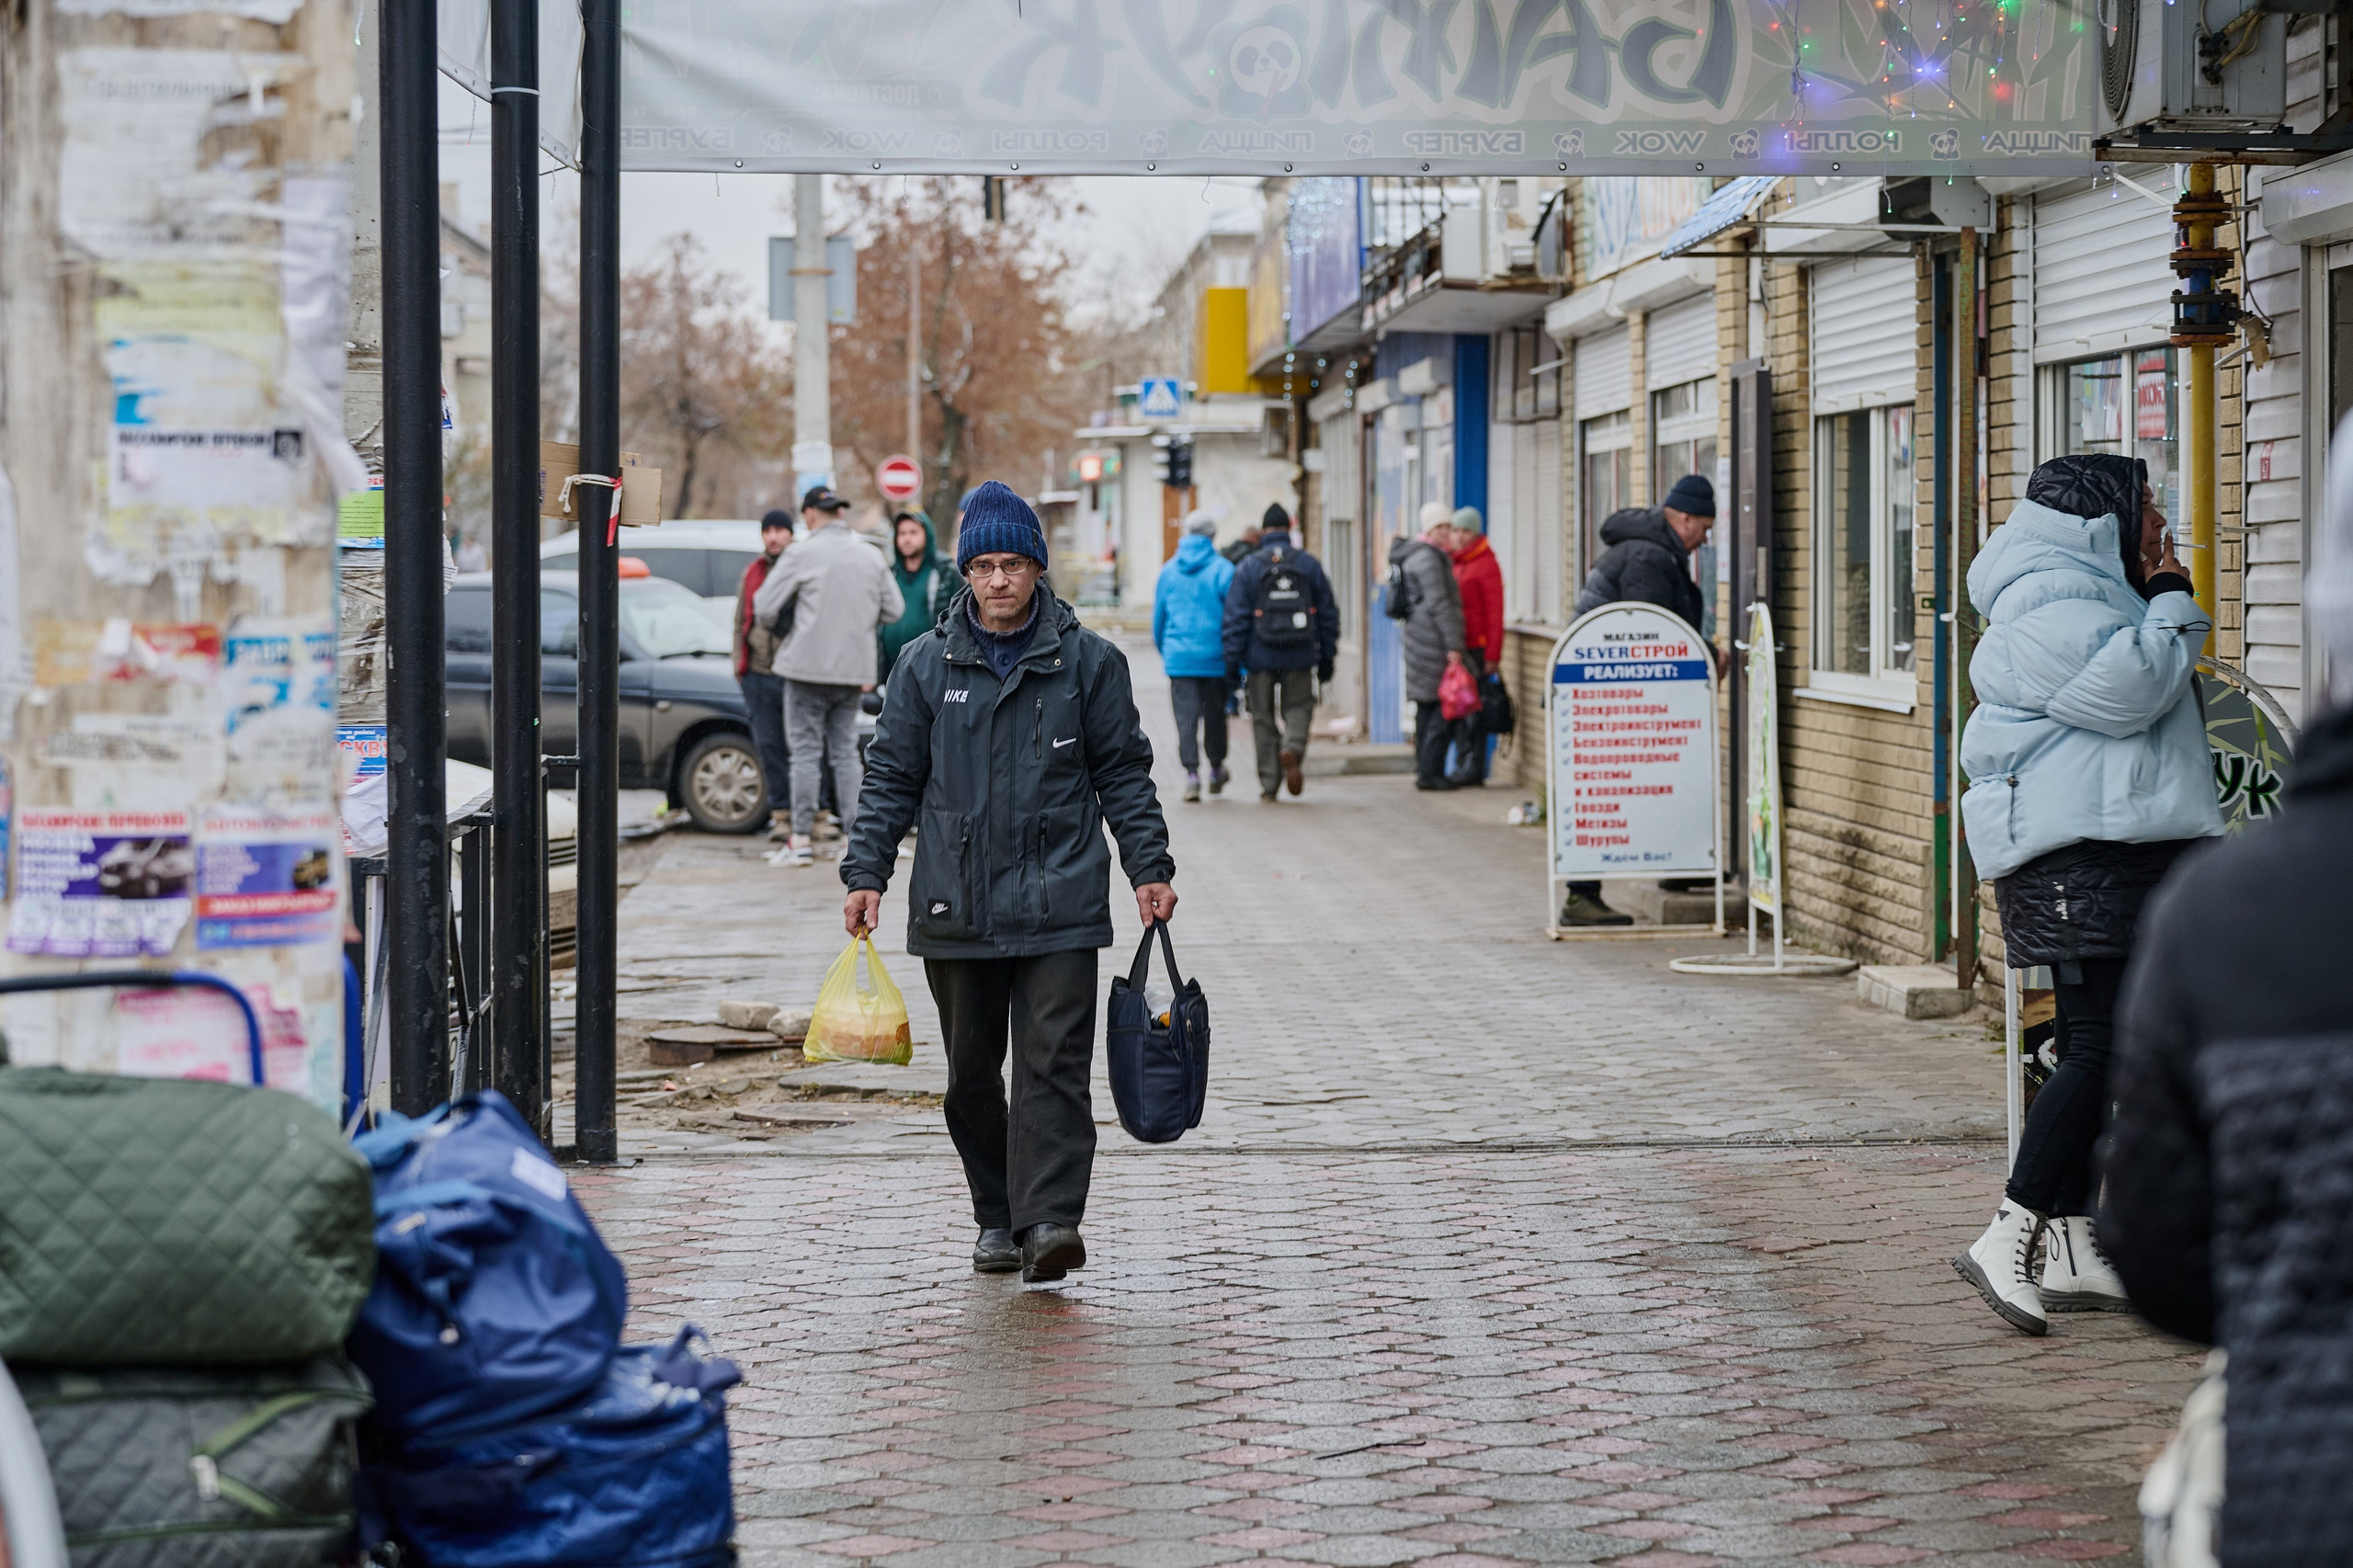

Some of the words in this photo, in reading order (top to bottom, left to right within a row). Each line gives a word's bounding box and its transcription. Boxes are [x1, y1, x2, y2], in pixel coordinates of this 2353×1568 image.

[1603, 632, 1660, 642] МАГАЗИН
[1583, 663, 1678, 681] РЕАЛИЗУЕТ:
[1572, 688, 1643, 700] Хозтовары
[1573, 719, 1702, 733] Электроинструмент
[1574, 736, 1688, 749] Бензоинструмент
[1574, 752, 1680, 765] Водопроводные
[1574, 770, 1632, 780] системы
[1574, 788, 1582, 797] и
[1574, 802, 1620, 813] Гвозди
[1575, 818, 1628, 829] Метизы
[1576, 835, 1630, 846] Шурупы
